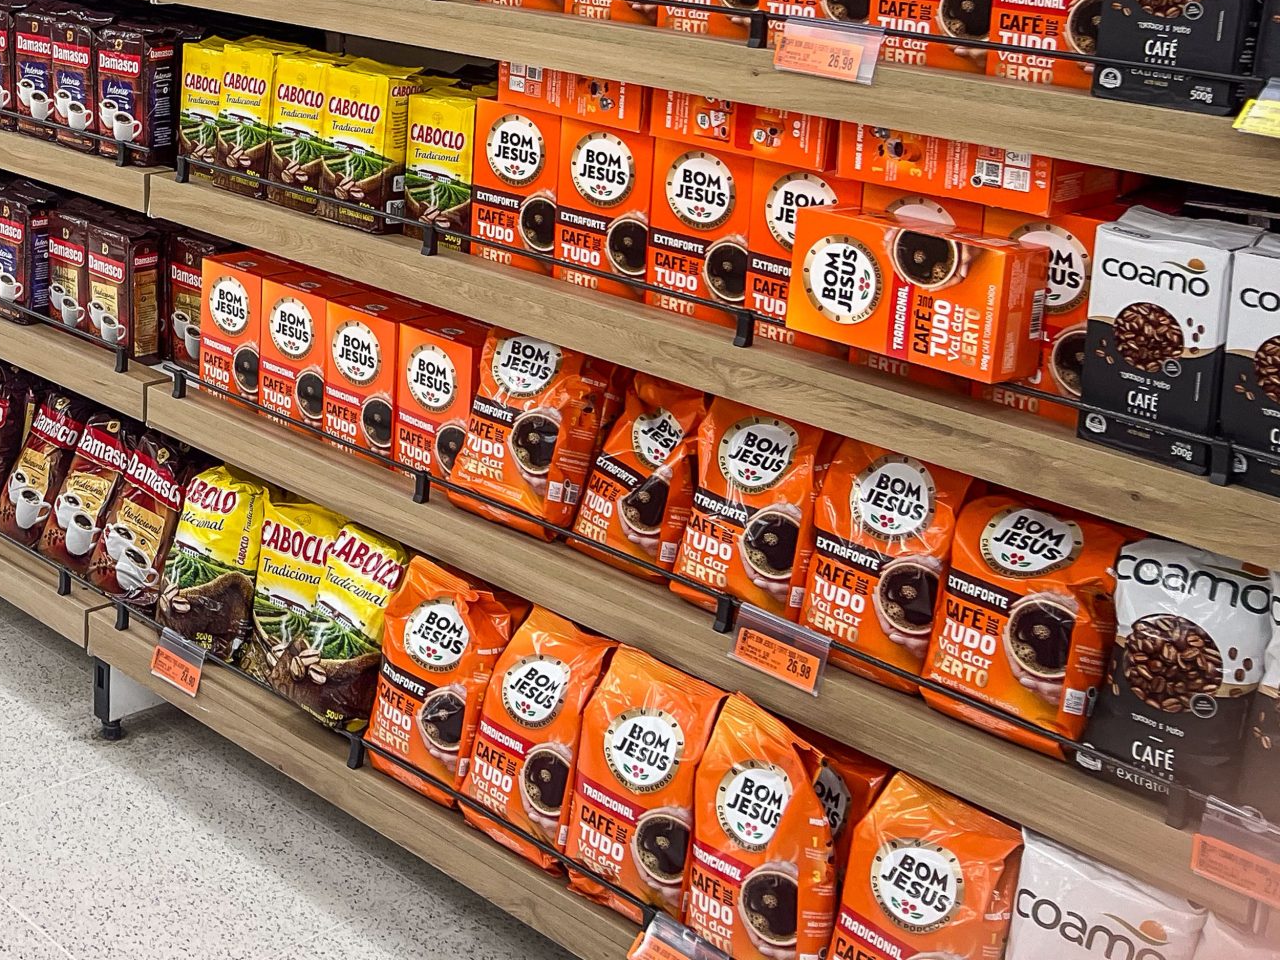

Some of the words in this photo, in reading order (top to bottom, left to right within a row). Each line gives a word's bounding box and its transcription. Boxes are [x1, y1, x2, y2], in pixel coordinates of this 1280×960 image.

[1000, 13, 1043, 36] CAFÉ
[1044, 18, 1059, 37] QUE
[53, 45, 89, 65] Damasco
[98, 52, 139, 73] Damasco
[1145, 39, 1178, 58] CAFÉ
[223, 71, 266, 95] CABOCLO
[1190, 90, 1213, 103] 500g
[328, 96, 380, 122] CABOCLO
[332, 121, 375, 135] Tradicional
[410, 123, 465, 151] CABOCLO
[414, 149, 460, 163] Tradicional
[682, 169, 721, 190] BOM
[675, 183, 726, 207] JESUS
[49, 239, 83, 262] Damasco
[654, 234, 704, 254] EXTRAFORTE
[89, 255, 122, 278] Damasco
[655, 252, 687, 273] CAFÉ
[822, 252, 840, 301] BOM
[654, 268, 698, 291] TUDO
[838, 247, 858, 312] JESUS
[1101, 258, 1210, 297] coamo
[893, 286, 909, 350] TRADICIONAL
[913, 307, 932, 355] CAFÉ
[930, 300, 951, 357] TUDO
[952, 303, 965, 332] dar
[339, 346, 375, 369] JESUS
[343, 334, 372, 355] BOM
[948, 334, 960, 361] Vai
[1128, 389, 1159, 412] CAFÉ
[325, 415, 357, 437] TUDO
[1171, 444, 1193, 460] 500g
[877, 472, 921, 505] BOM
[861, 488, 925, 521] JESUS
[122, 504, 161, 536] Tradicional
[237, 536, 250, 565] CABOCLO
[332, 529, 404, 592] CABOCLO
[816, 536, 880, 571] EXTRAFORTE
[325, 566, 388, 607] Tradicional
[813, 576, 866, 614] TUDO
[1116, 554, 1270, 616] coamo
[806, 607, 858, 643] CERTO
[523, 667, 560, 695] BOM
[786, 658, 812, 680] 26,98
[509, 678, 553, 709] JESUS
[480, 721, 524, 755] TRADICIONAL
[628, 723, 670, 753] BOM
[615, 737, 668, 772] JESUS
[1132, 741, 1174, 771] CAFÉ
[582, 783, 635, 820] TRADICIONAL
[900, 854, 949, 892] BOM
[881, 867, 950, 913] JESUS
[840, 912, 903, 960] TRADICIONAL
